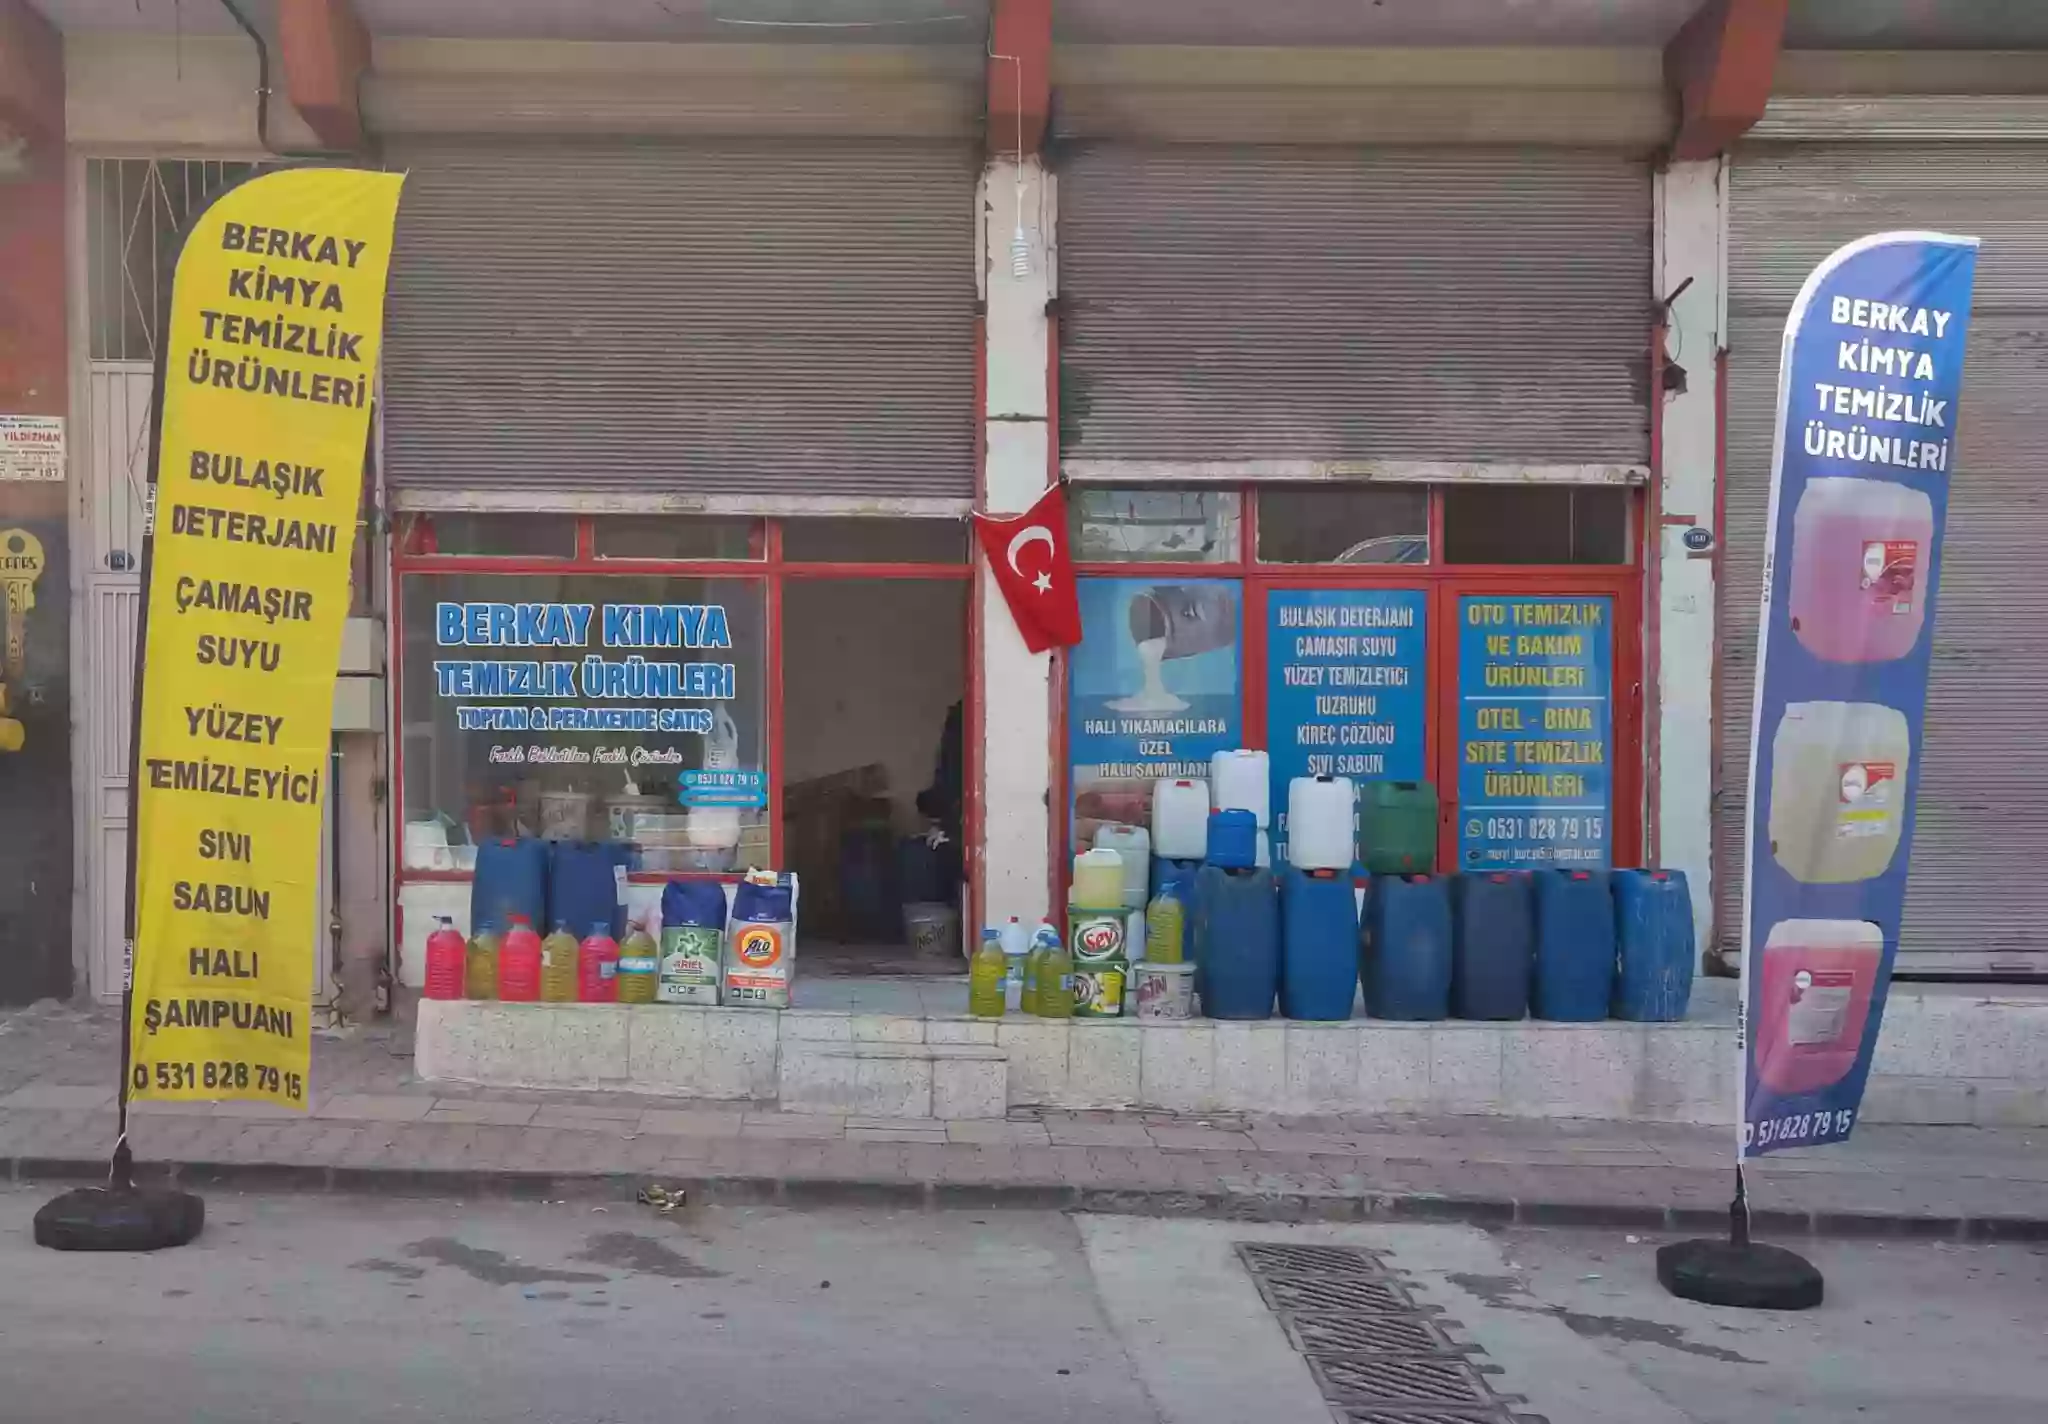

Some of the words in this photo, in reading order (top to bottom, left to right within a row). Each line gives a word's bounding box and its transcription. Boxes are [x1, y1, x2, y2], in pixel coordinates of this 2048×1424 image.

[222, 222, 367, 269] BERKAY
[228, 265, 344, 313] KİMYA
[1831, 296, 1952, 338] BERKAY
[200, 310, 364, 362] TEMİZLİK
[1837, 338, 1934, 381] KİMYA
[188, 349, 367, 409] ÜRÜNLERİ
[1814, 383, 1948, 428] TEMİZLİK
[1803, 420, 1948, 471] ÜRÜNLERİ
[189, 450, 326, 500] BULAŞIK
[172, 504, 337, 554] DETERJANI
[176, 576, 314, 626] ÇAMAŞIR
[1279, 606, 1337, 629] BULAŞIK
[1340, 606, 1413, 629] DETERJANI
[1468, 604, 1505, 626] OTO
[1512, 604, 1602, 626] TEMİZLİK
[436, 602, 595, 646] BERKAY
[602, 604, 732, 648] KİMYA
[196, 634, 281, 672] SUYU
[1296, 636, 1357, 657] ÇAMAŞIR
[1361, 636, 1397, 657] SUYU
[1487, 635, 1510, 656] VE
[1517, 635, 1582, 656] BAKIM
[1283, 663, 1325, 686] YÜZEY
[1328, 665, 1408, 687] TEMİZLEYİCİ
[1485, 661, 1584, 687] ÜRÜNLERİ
[456, 706, 528, 730] TOPTAN
[530, 707, 547, 730] &
[549, 708, 657, 732] PERAKENDE
[659, 709, 712, 734] SATIŞ
[1315, 695, 1377, 716] TUZRUHU
[1477, 708, 1524, 730] OTEL
[1545, 708, 1592, 730] BİNA
[184, 702, 284, 746] YÜZEY
[1085, 719, 1117, 735] HALI
[1120, 719, 1227, 735] YIKAMACILARA
[1297, 722, 1336, 746] KİREÇ
[1340, 722, 1395, 746] ÇÖZÜCÜ
[1139, 738, 1173, 756] ÖZEL
[1307, 754, 1333, 774] SIVI
[1337, 754, 1384, 774] SABUN
[1466, 741, 1506, 764] SİTE
[1514, 741, 1604, 764] TEMİZLİK
[145, 756, 319, 805] TEMİZLEYİCİ
[1099, 762, 1132, 777] HALI
[1485, 770, 1584, 797] ÜRÜNLERİ
[1487, 816, 1525, 840] 0531
[1529, 817, 1556, 840] 828
[1561, 817, 1579, 840] 79
[1585, 817, 1602, 840] 15
[198, 828, 251, 864] SIVI
[173, 881, 270, 920] SABUN
[189, 947, 258, 979] HALI
[144, 998, 293, 1039] ŞAMPUANI
[133, 1063, 149, 1090] 0
[156, 1062, 195, 1090] 531
[203, 1061, 249, 1090] 828
[255, 1064, 280, 1093] 79
[284, 1071, 302, 1101] 15
[1780, 1114, 1810, 1139] 828
[1813, 1111, 1832, 1138] 79
[1835, 1109, 1853, 1134] 15
